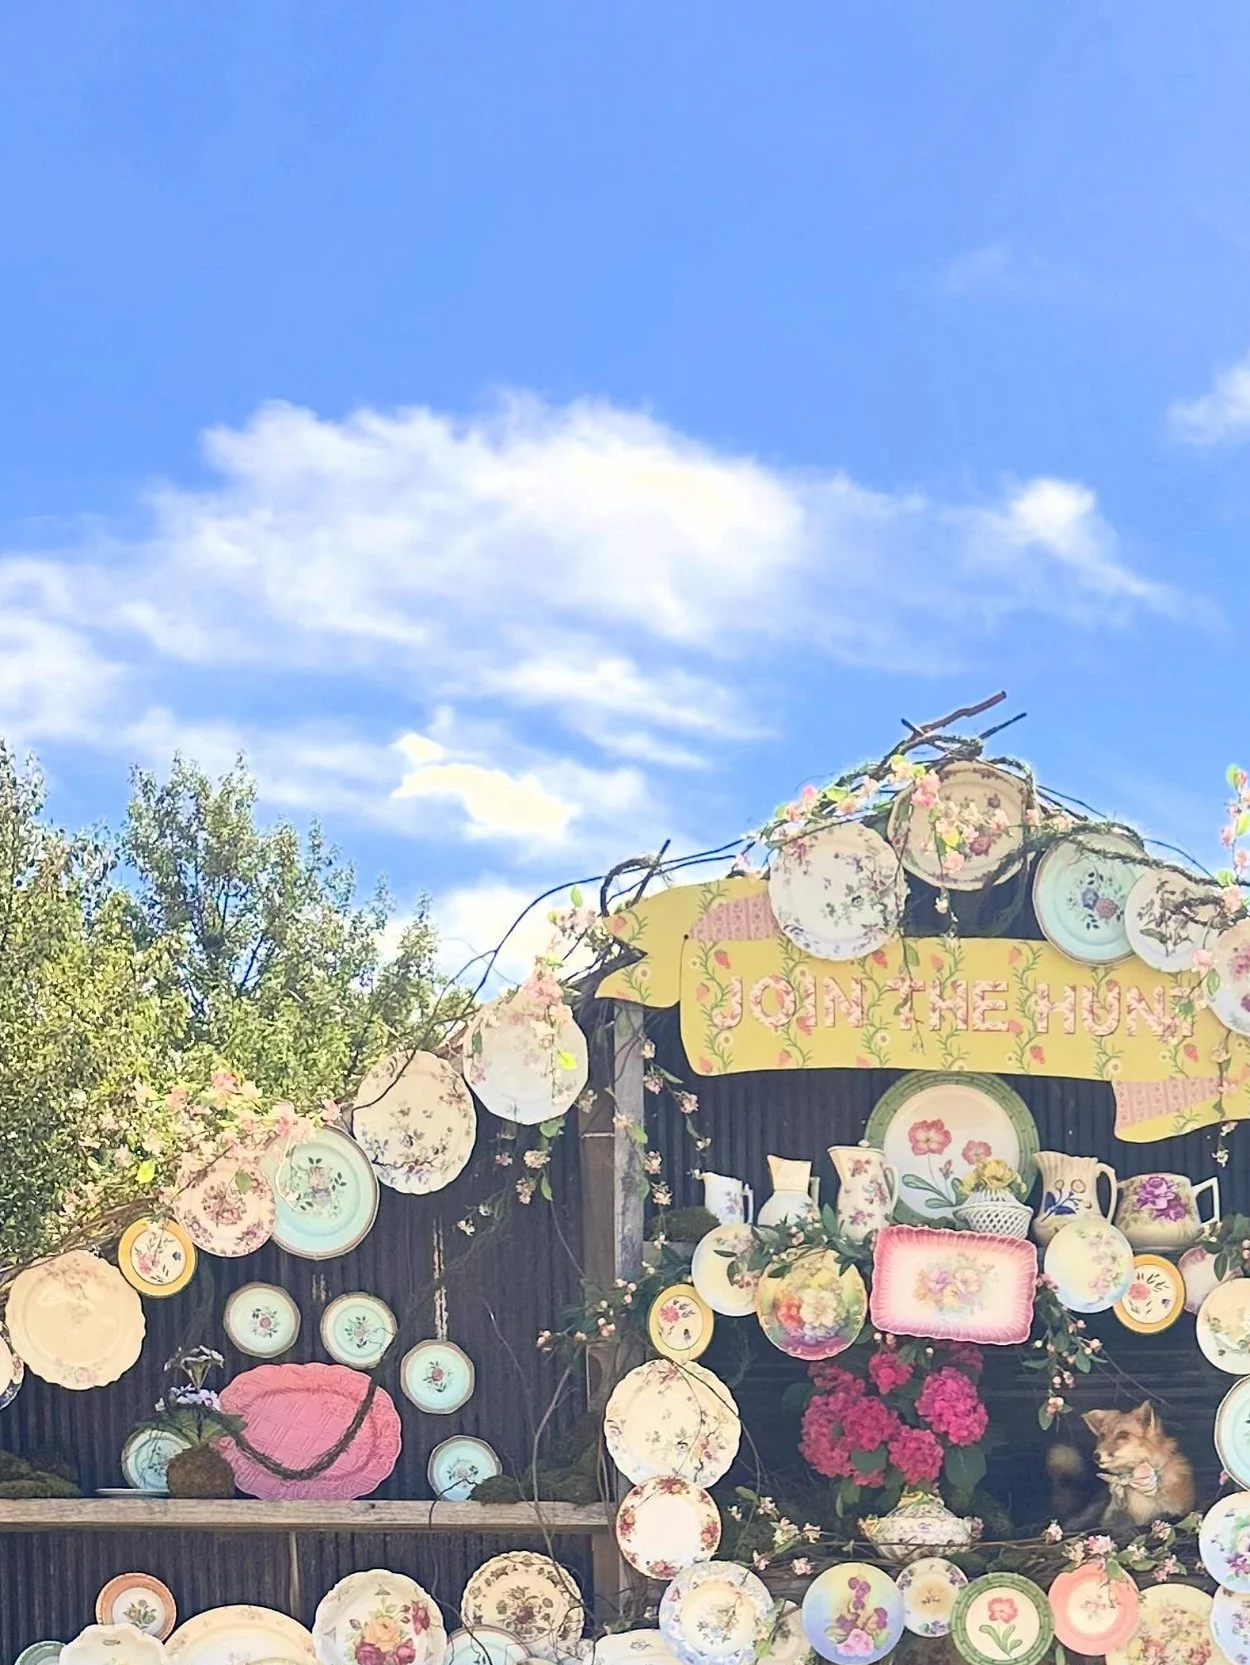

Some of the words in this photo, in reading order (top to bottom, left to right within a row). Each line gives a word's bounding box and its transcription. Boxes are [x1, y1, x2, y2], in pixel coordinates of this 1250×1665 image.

[711, 975, 864, 1029] JOIN
[886, 979, 1009, 1032] THE
[1034, 983, 1204, 1037] HUNT
